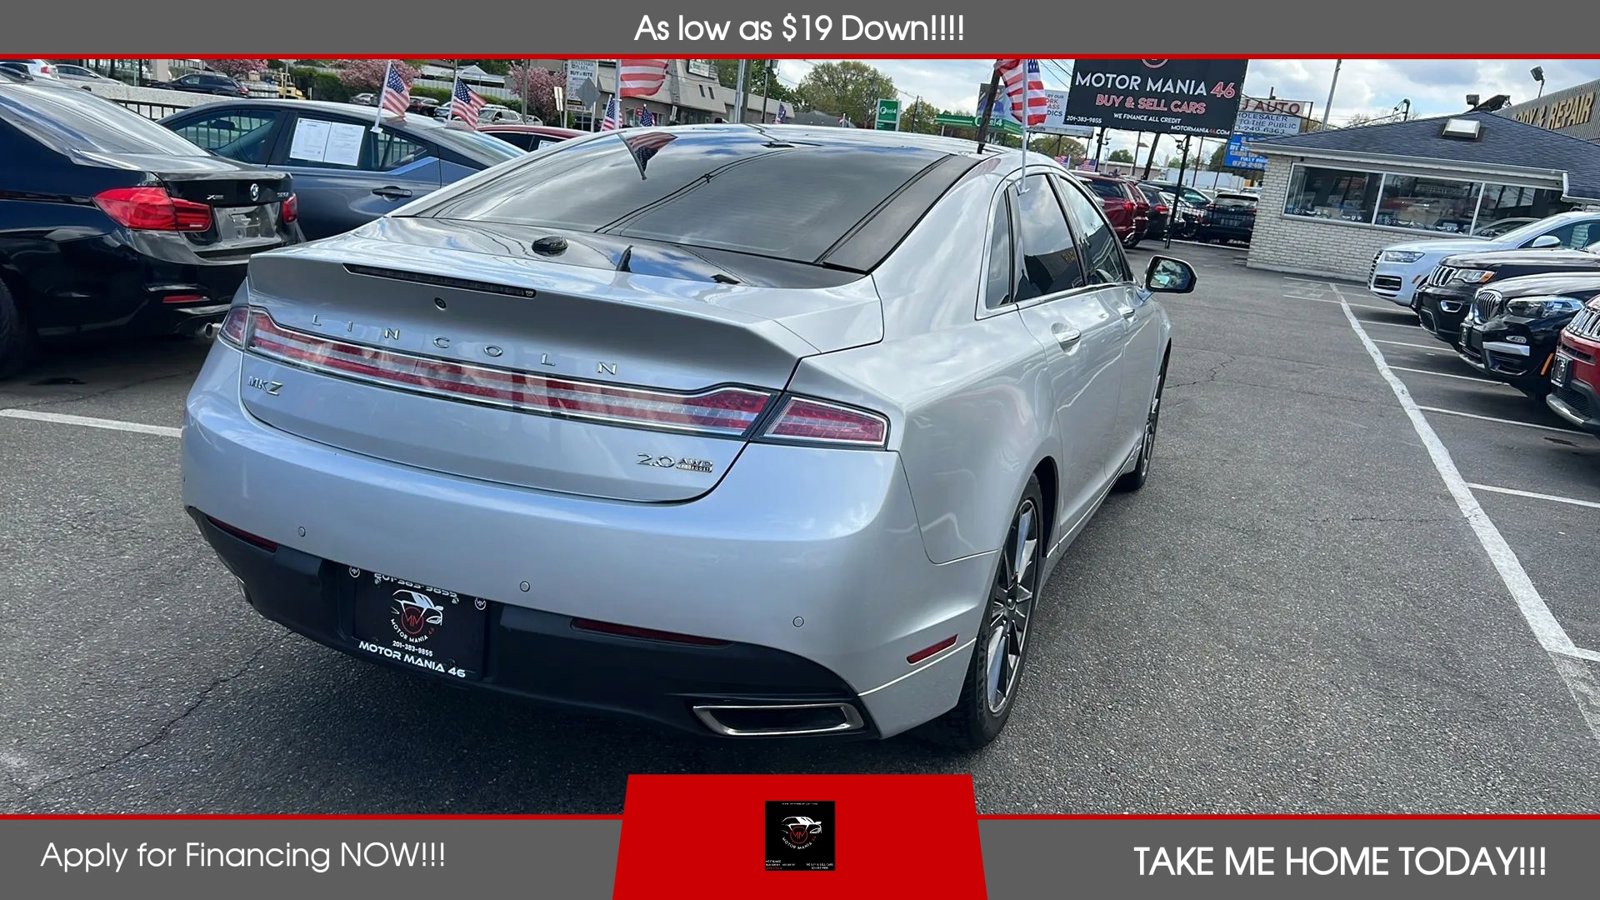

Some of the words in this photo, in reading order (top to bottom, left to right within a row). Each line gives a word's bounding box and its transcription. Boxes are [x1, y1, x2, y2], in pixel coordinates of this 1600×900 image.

[1075, 71, 1141, 91] MOTOR
[1146, 77, 1207, 96] MANIA
[1210, 81, 1236, 99] 46
[1095, 93, 1124, 108] BUY
[1125, 96, 1135, 108] &
[1138, 97, 1168, 111] SELL
[1170, 100, 1207, 114] CARS
[1242, 99, 1250, 110] J
[1254, 100, 1300, 114] AUTO
[1547, 91, 1595, 130] REPAIR
[1123, 113, 1147, 122] FINANCE
[1148, 115, 1159, 123] ALL
[1160, 116, 1182, 124] CREDIT
[1267, 121, 1297, 129] PUBLIC
[311, 314, 617, 375] LINCOLN
[248, 376, 283, 396] MKZ
[637, 453, 675, 468] 2.0
[390, 618, 408, 639] MOTOR
[409, 635, 429, 643] MANIA
[358, 640, 402, 661] MOTOR
[403, 654, 445, 673] MANIA
[447, 667, 466, 678] 46
